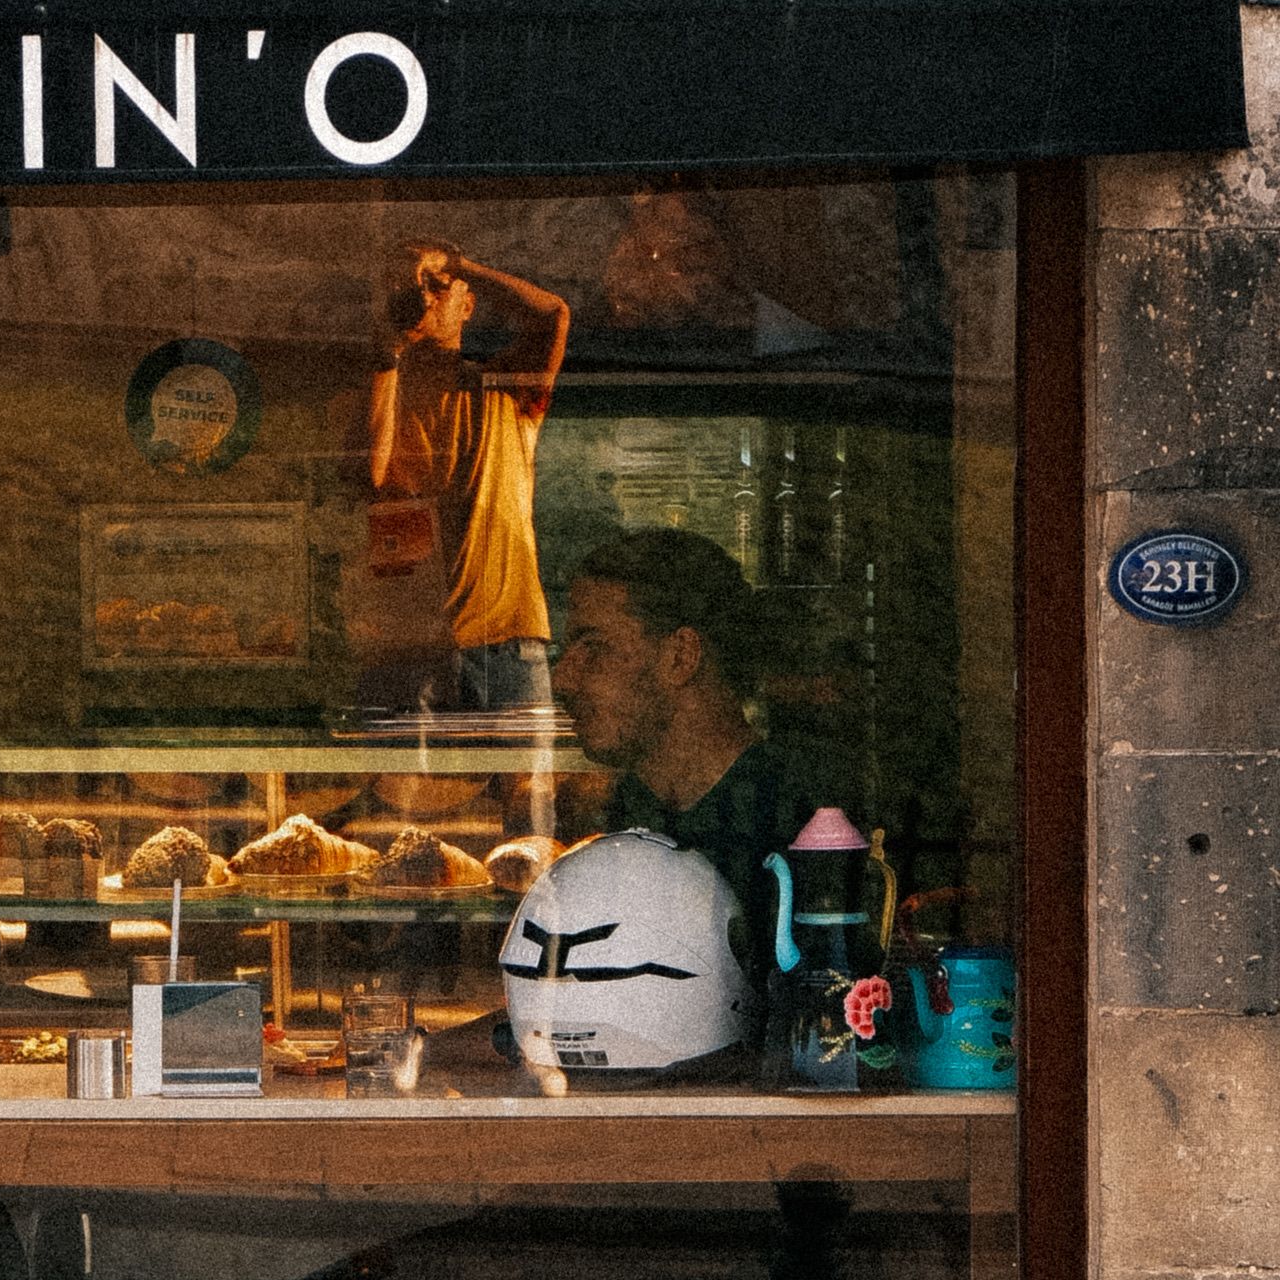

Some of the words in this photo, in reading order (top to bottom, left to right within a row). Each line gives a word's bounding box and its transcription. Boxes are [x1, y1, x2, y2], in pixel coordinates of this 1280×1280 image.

[175, 389, 216, 404] SELF
[158, 406, 229, 423] SERVICE
[1141, 560, 1216, 592] 23H
